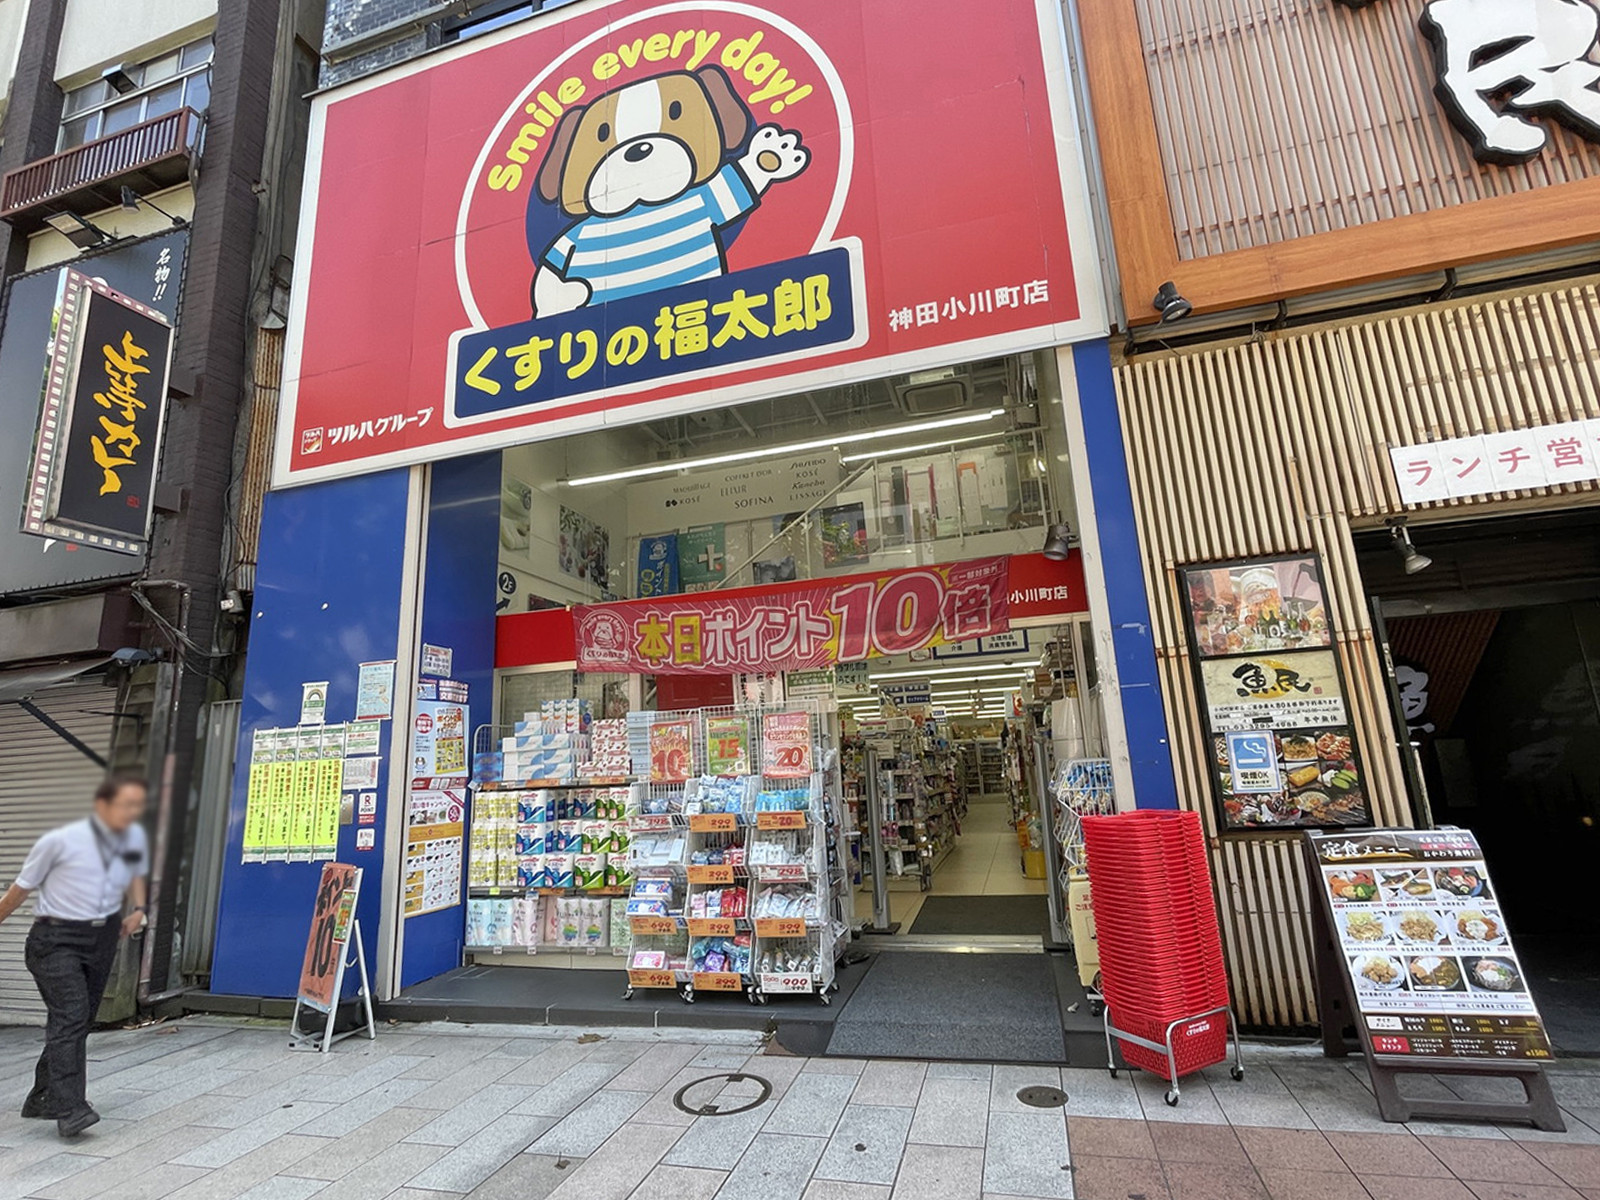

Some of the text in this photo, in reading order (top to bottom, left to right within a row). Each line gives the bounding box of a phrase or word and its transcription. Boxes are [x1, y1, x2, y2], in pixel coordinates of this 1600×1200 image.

[592, 30, 721, 81] every
[720, 31, 813, 114] day!
[889, 279, 1049, 332] 神田小川町店
[464, 274, 831, 396] くすりの福太郎
[328, 407, 434, 445] ツルハグループ
[1405, 433, 1600, 486] ランチ営
[734, 496, 774, 509] SOFINA
[501, 574, 514, 592] 2F
[1007, 585, 1068, 605] 小川町店
[1232, 661, 1311, 697] 魚民
[718, 739, 739, 759] 15
[777, 747, 804, 767] 20
[1240, 771, 1269, 779] 喫煙OK
[1321, 840, 1410, 858] 定食メニュー
